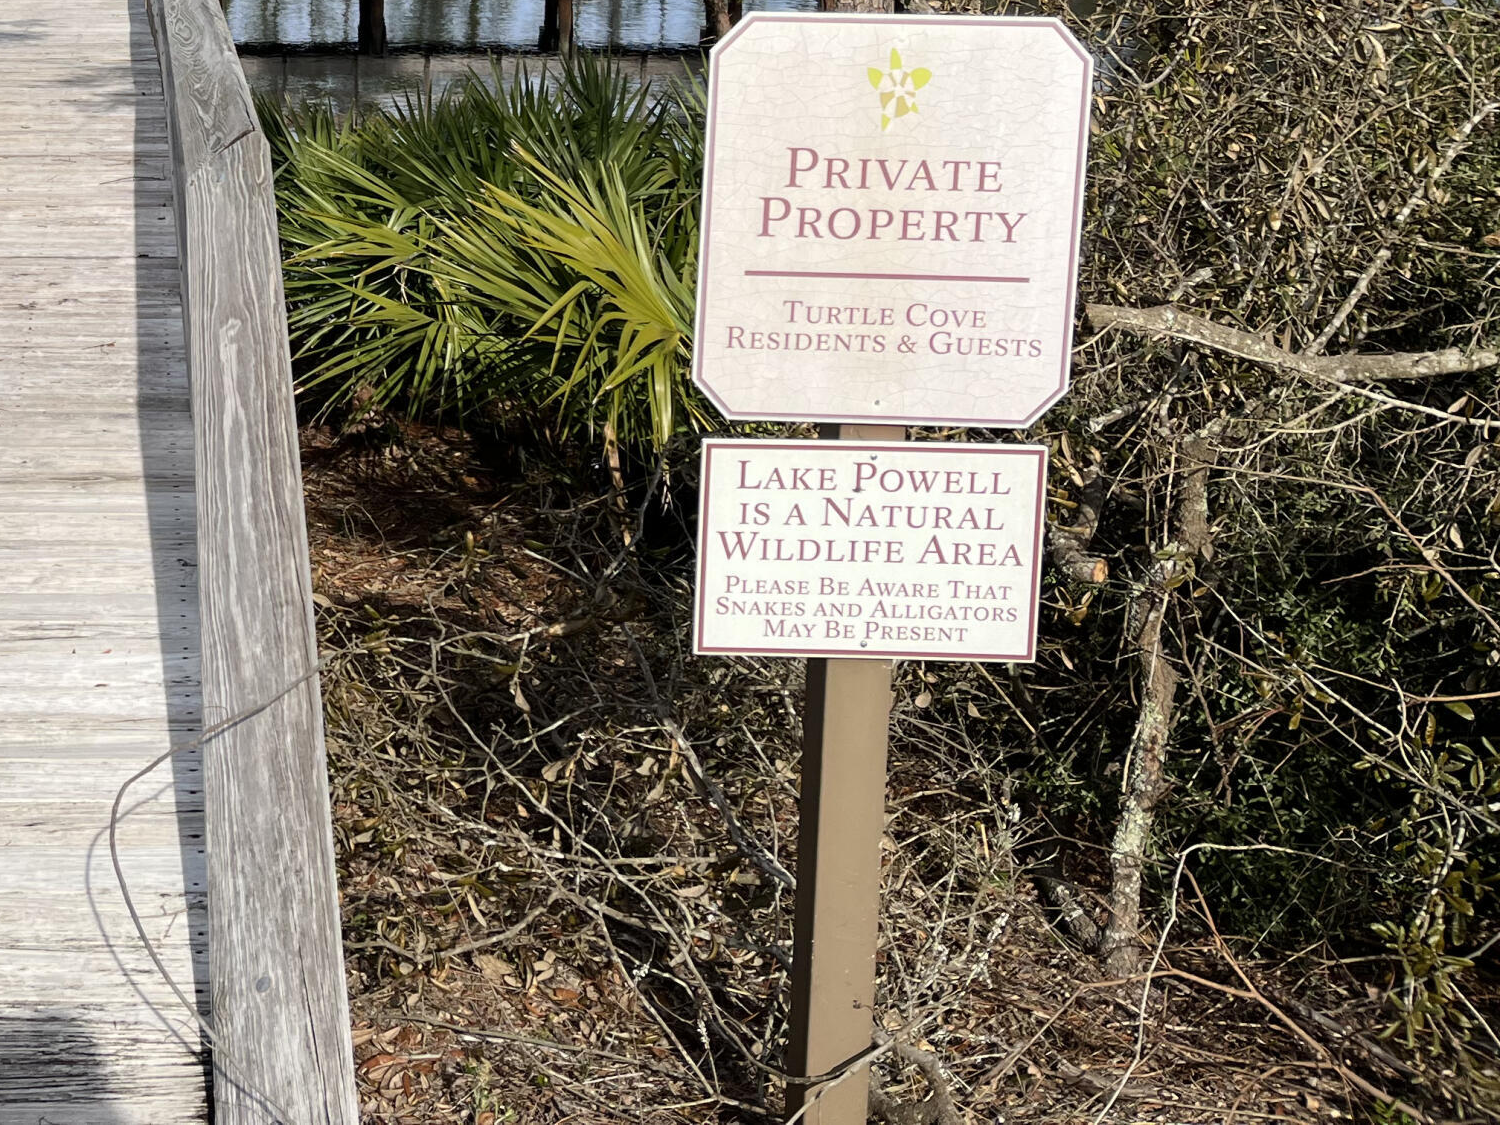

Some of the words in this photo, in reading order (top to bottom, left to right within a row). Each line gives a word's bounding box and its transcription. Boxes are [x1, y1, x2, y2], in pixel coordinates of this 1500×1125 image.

[783, 147, 1002, 193] PRIVATE
[756, 196, 1028, 243] PROPERTY
[783, 300, 894, 326] TURTLE
[906, 303, 986, 328] COVE
[726, 326, 886, 353] RESIDENTS
[897, 335, 917, 354] &
[929, 331, 1042, 357] GUESTS
[737, 460, 837, 491] LAKE
[852, 462, 1011, 495] POWELL
[738, 503, 770, 525] IS
[783, 504, 808, 525] A
[821, 497, 1004, 530] NATURAL
[716, 531, 903, 563] WILDLIFE
[917, 535, 1023, 567] AREA
[725, 575, 809, 595] PLEASE
[819, 577, 849, 596] BE
[857, 578, 939, 598] AWARE
[948, 581, 1012, 600] THAT
[716, 597, 805, 617] SNAKES
[813, 603, 862, 617] AND
[869, 600, 1018, 622] ALLIGATORS
[763, 619, 816, 638] MAY
[825, 621, 855, 639] BE
[864, 622, 968, 642] PRESENT
